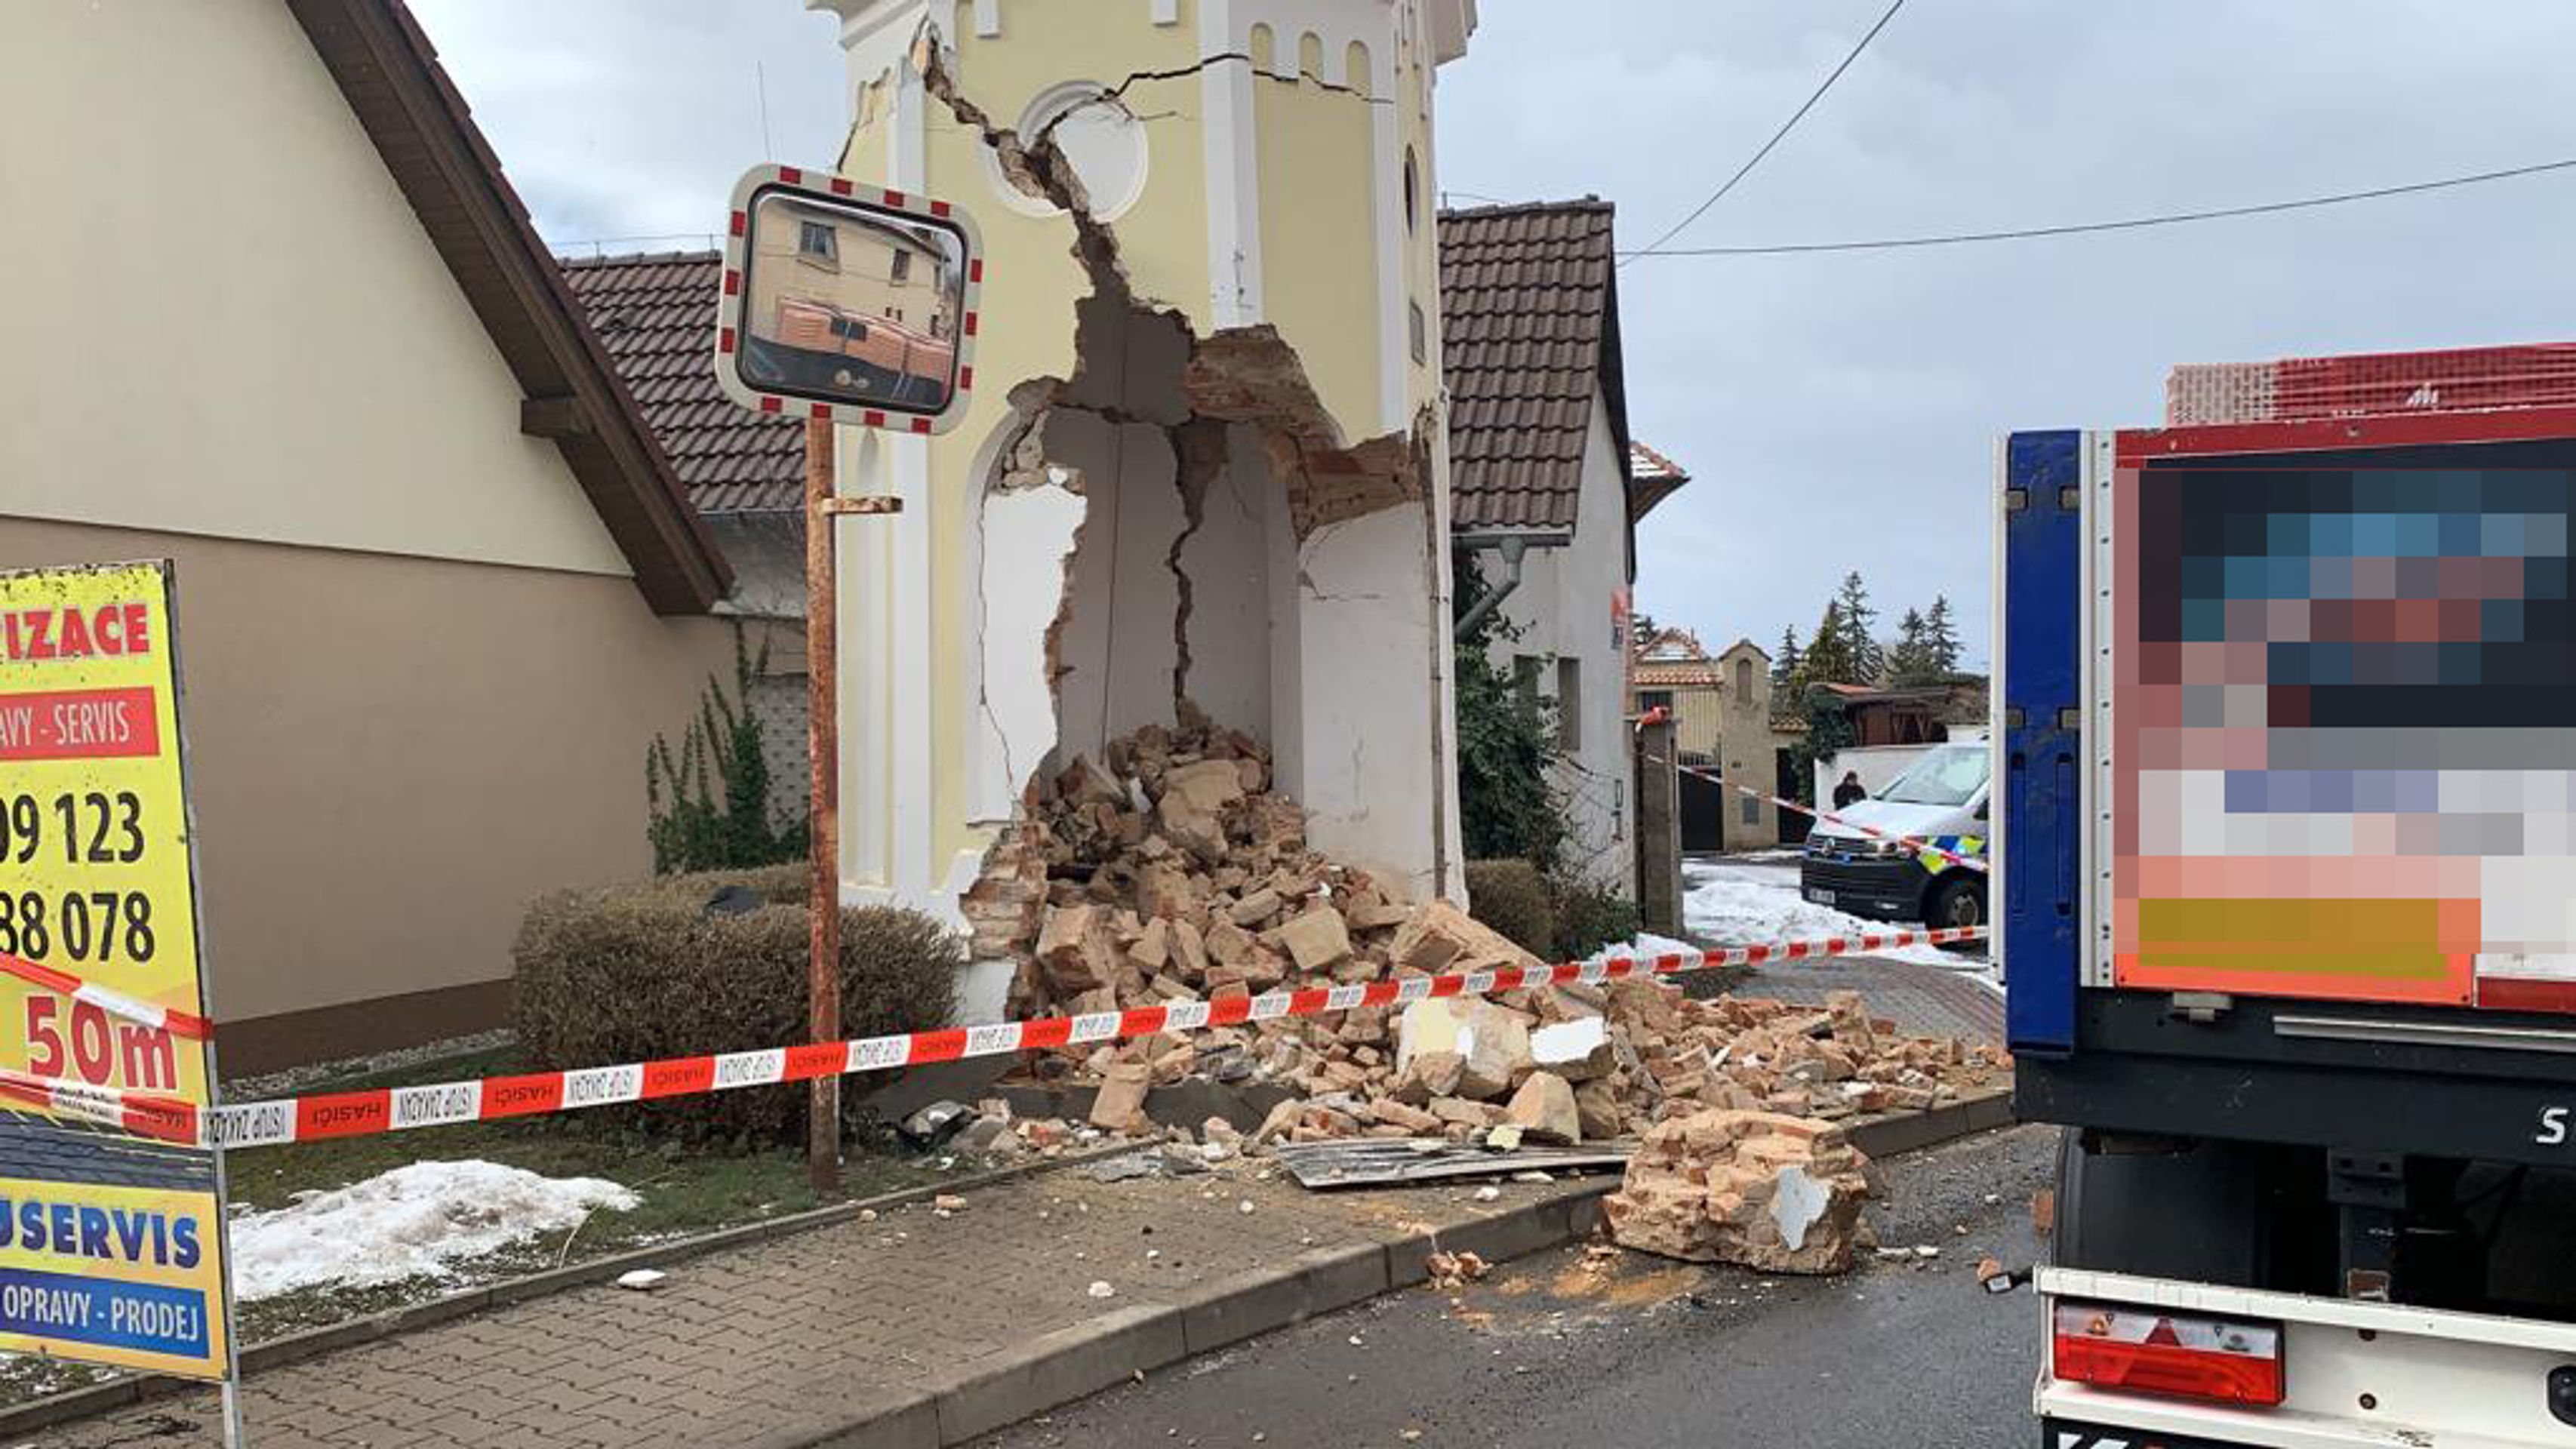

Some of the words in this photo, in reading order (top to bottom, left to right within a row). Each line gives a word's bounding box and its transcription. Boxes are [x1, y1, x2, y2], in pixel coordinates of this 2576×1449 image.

[5, 604, 149, 660] IZACE
[54, 700, 130, 745] SERVIS
[55, 792, 145, 864] 123
[62, 891, 155, 963] 078
[27, 995, 177, 1090] 50m
[312, 1103, 381, 1128] HASIČI
[3, 1284, 91, 1327] OPRAVY
[111, 1297, 199, 1342] PRODEJ
